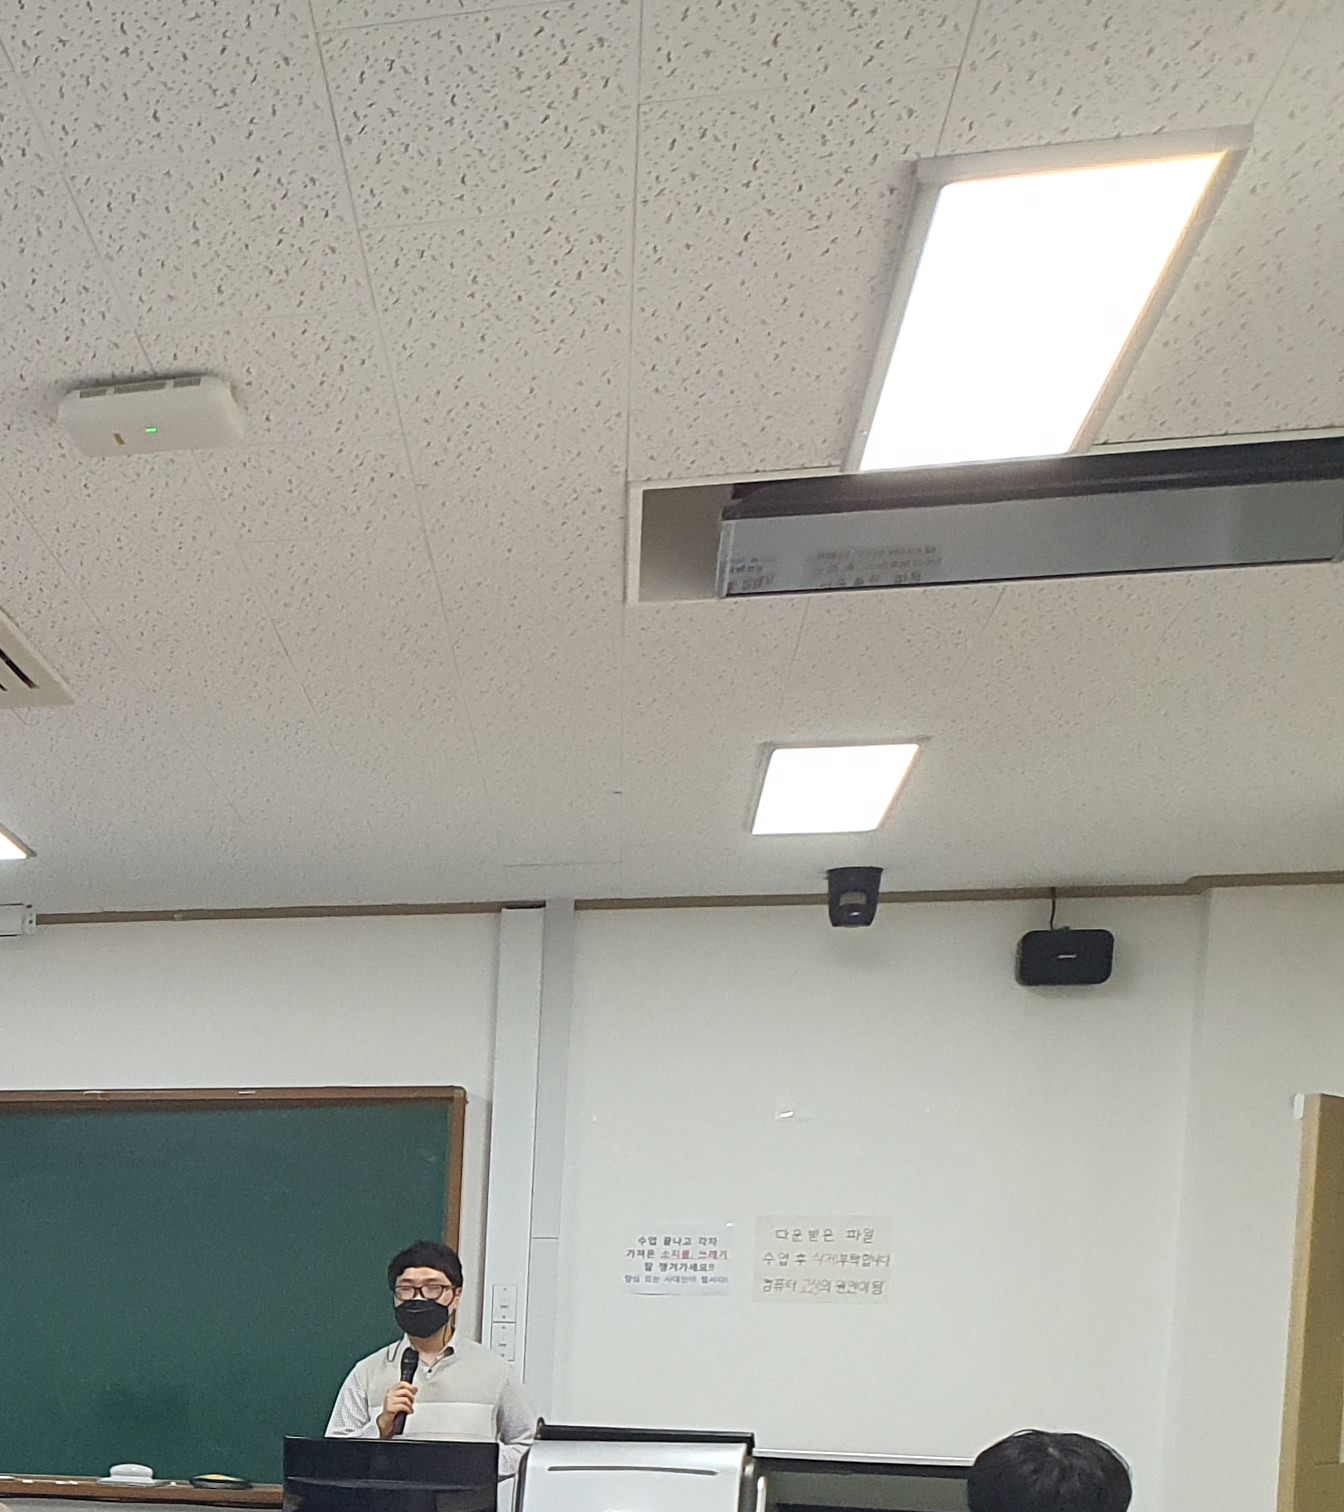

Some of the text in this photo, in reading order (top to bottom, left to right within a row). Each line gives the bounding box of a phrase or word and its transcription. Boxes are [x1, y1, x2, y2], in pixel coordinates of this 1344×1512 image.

[638, 1236, 657, 1246] 수업
[663, 1236, 692, 1247] 끝나고
[845, 1228, 874, 1243] 파일
[762, 1252, 789, 1267] 수업
[762, 1278, 797, 1293] 컴퓨터
